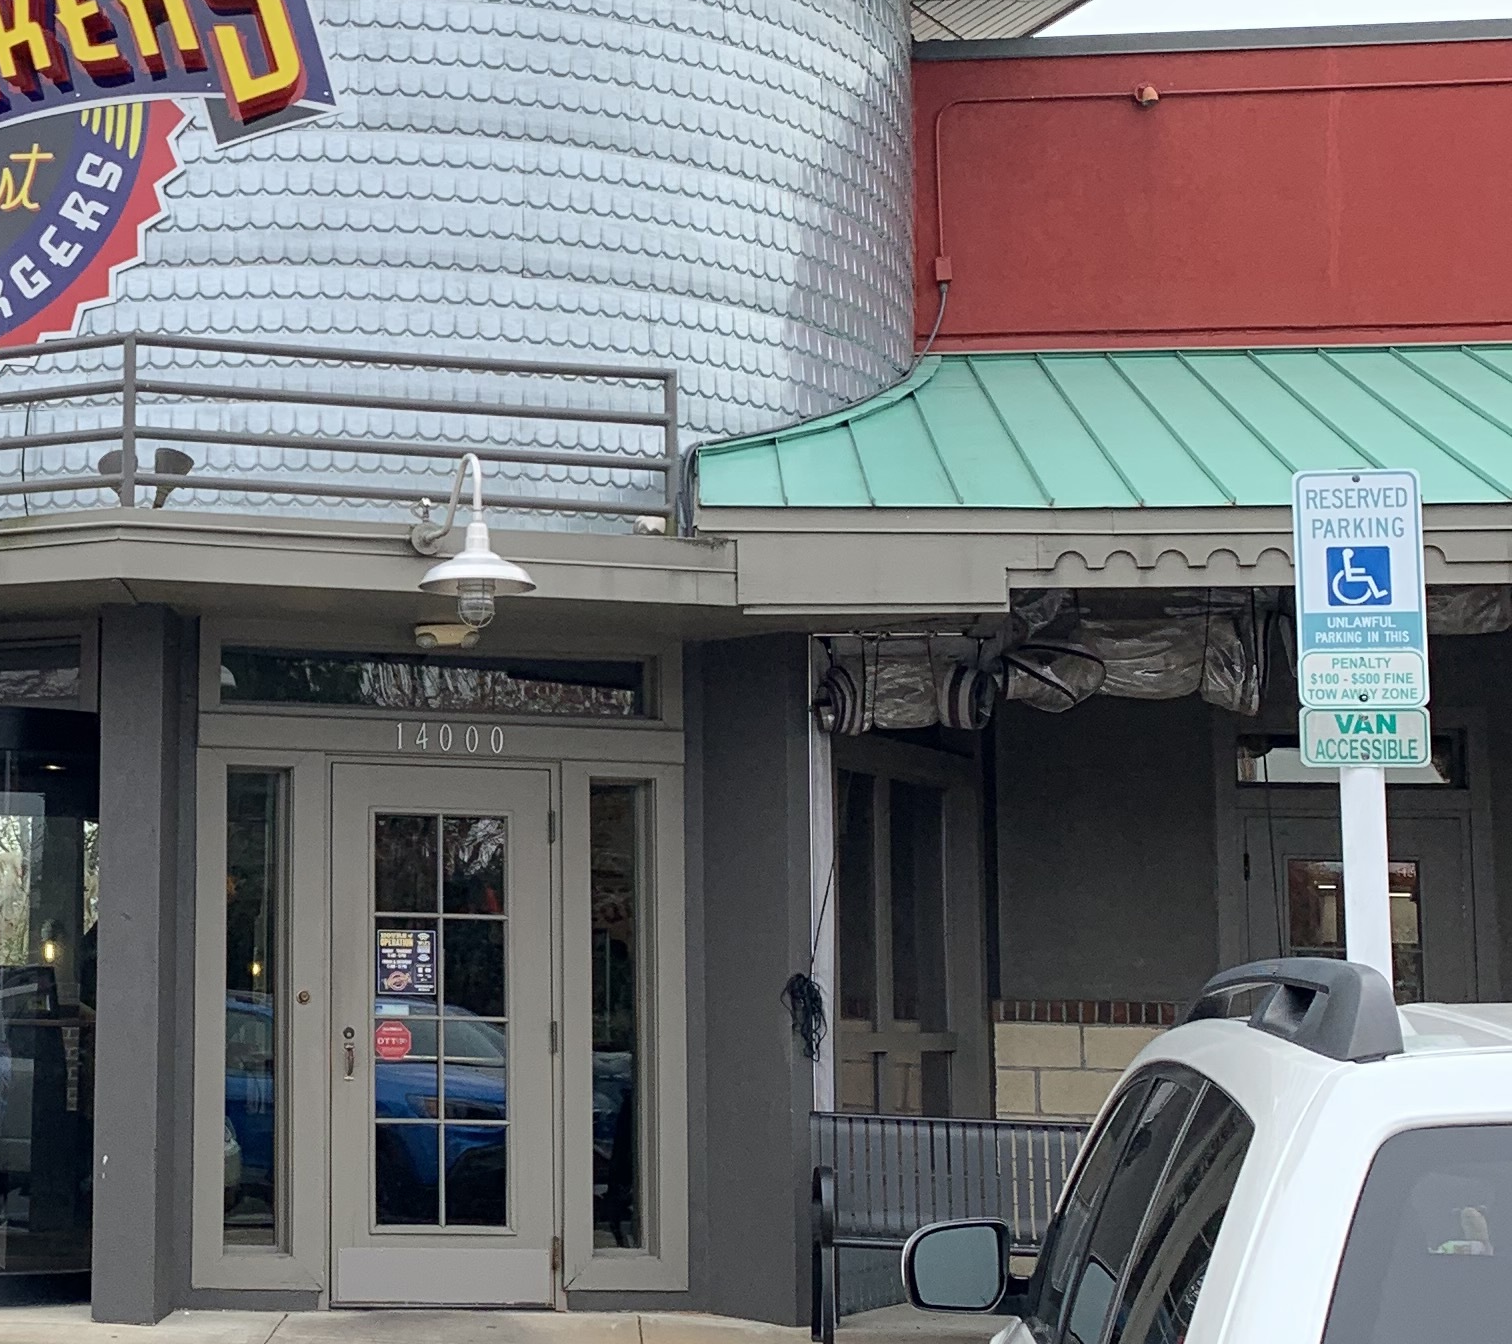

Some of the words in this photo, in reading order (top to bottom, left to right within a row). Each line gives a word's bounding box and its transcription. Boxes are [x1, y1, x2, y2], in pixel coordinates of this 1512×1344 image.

[1304, 487, 1408, 510] RESERVED
[1311, 516, 1406, 539] PARKING
[1326, 615, 1397, 629] UNLAWFUL
[1314, 630, 1363, 644] PARKING
[1367, 630, 1380, 643] IN
[1384, 630, 1410, 643] THIS
[1331, 657, 1392, 670] PENALTY
[1310, 673, 1340, 685] $100
[1351, 672, 1380, 685] $500
[1383, 672, 1414, 684] FINE
[1307, 688, 1338, 701] TOW
[1340, 688, 1378, 700] AWAY
[1381, 687, 1419, 700] ZONE
[1334, 713, 1398, 735] VAN
[395, 721, 505, 755] 14000
[1314, 738, 1419, 761] ACCESSIBLE
